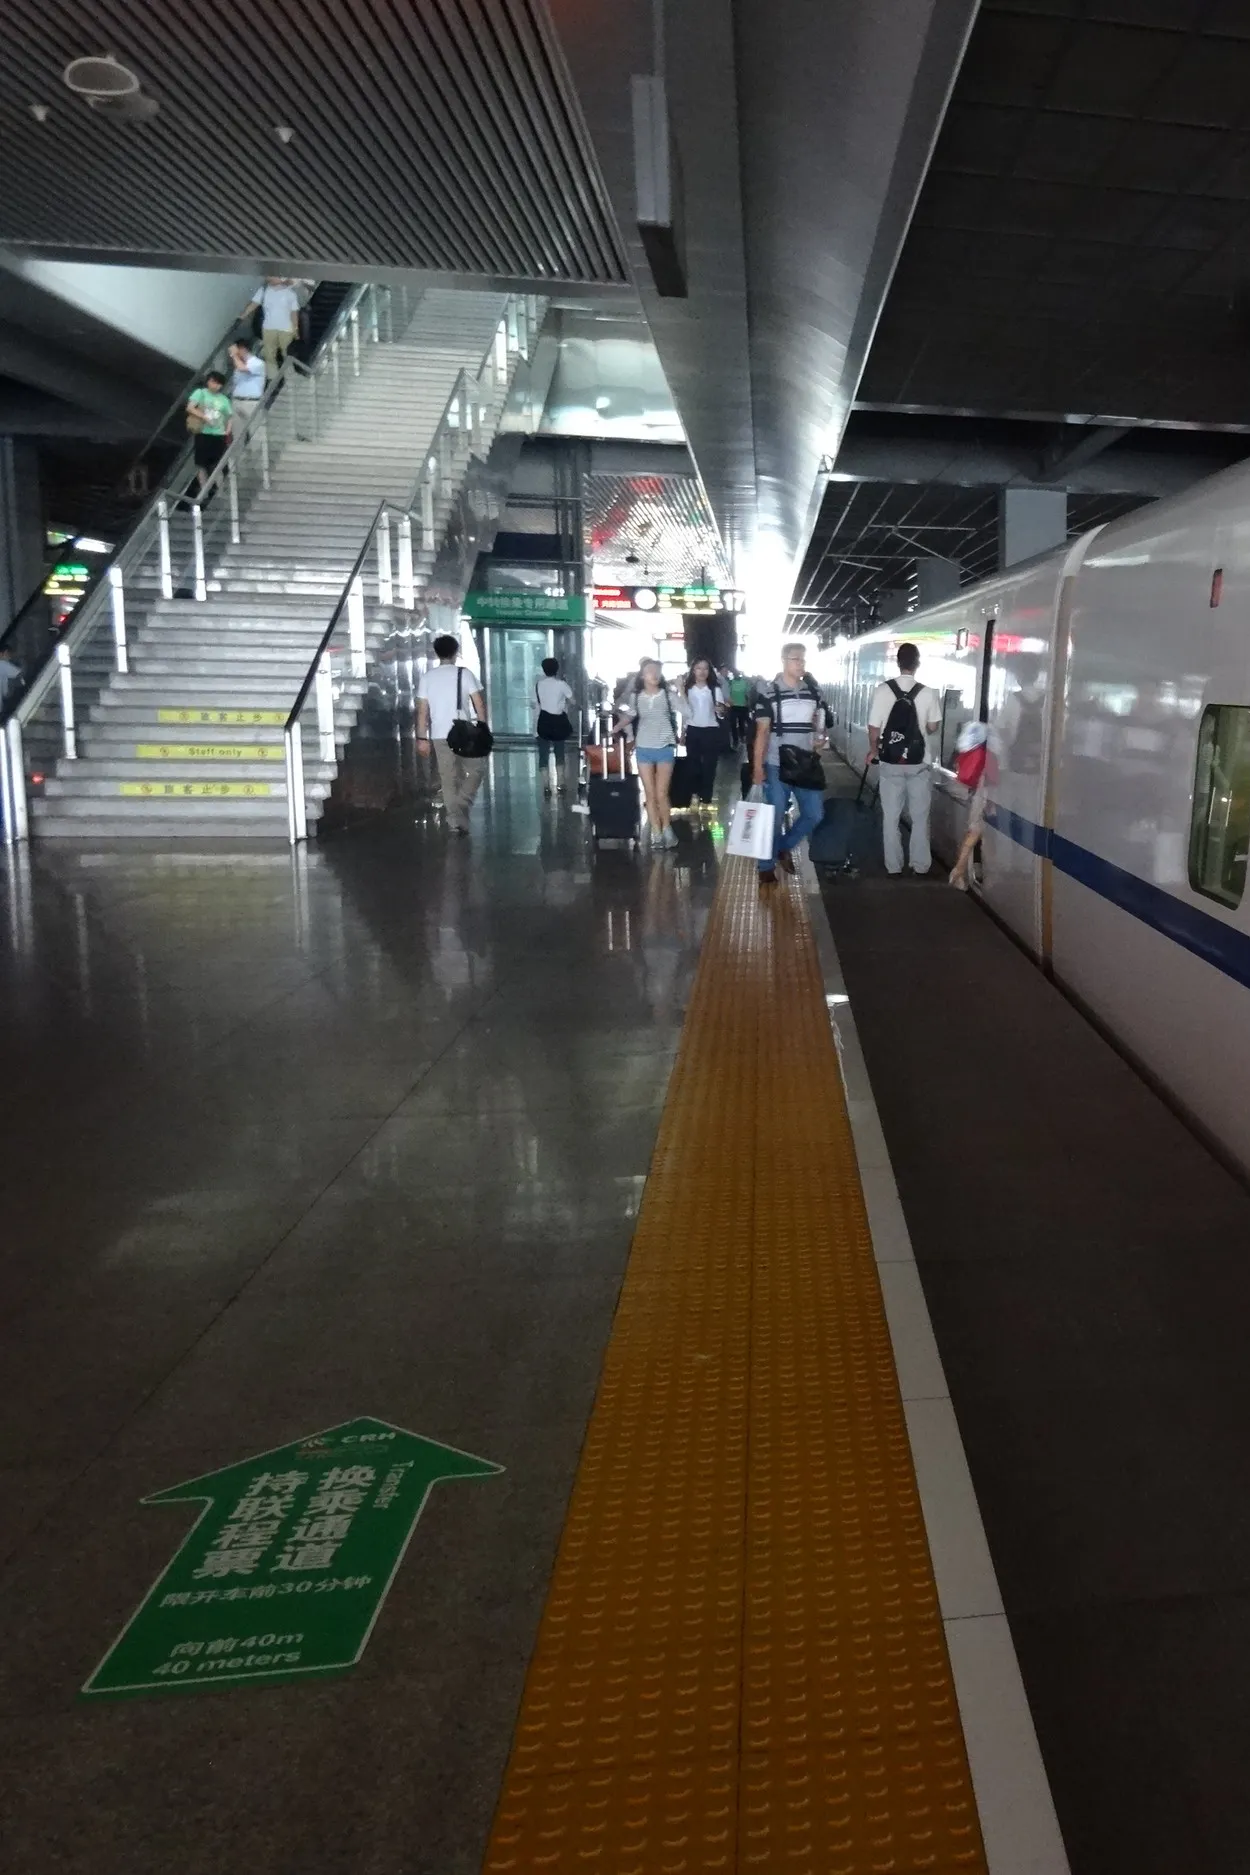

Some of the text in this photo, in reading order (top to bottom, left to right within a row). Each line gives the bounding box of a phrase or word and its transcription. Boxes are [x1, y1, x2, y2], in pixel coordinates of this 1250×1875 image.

[188, 748, 242, 758] Staff only
[341, 1432, 396, 1443] CRH
[192, 1470, 309, 1579] 持联程票
[270, 1466, 377, 1573] 换乘通道
[170, 1632, 304, 1657] 向前40m
[152, 1650, 301, 1676] 40 meters
